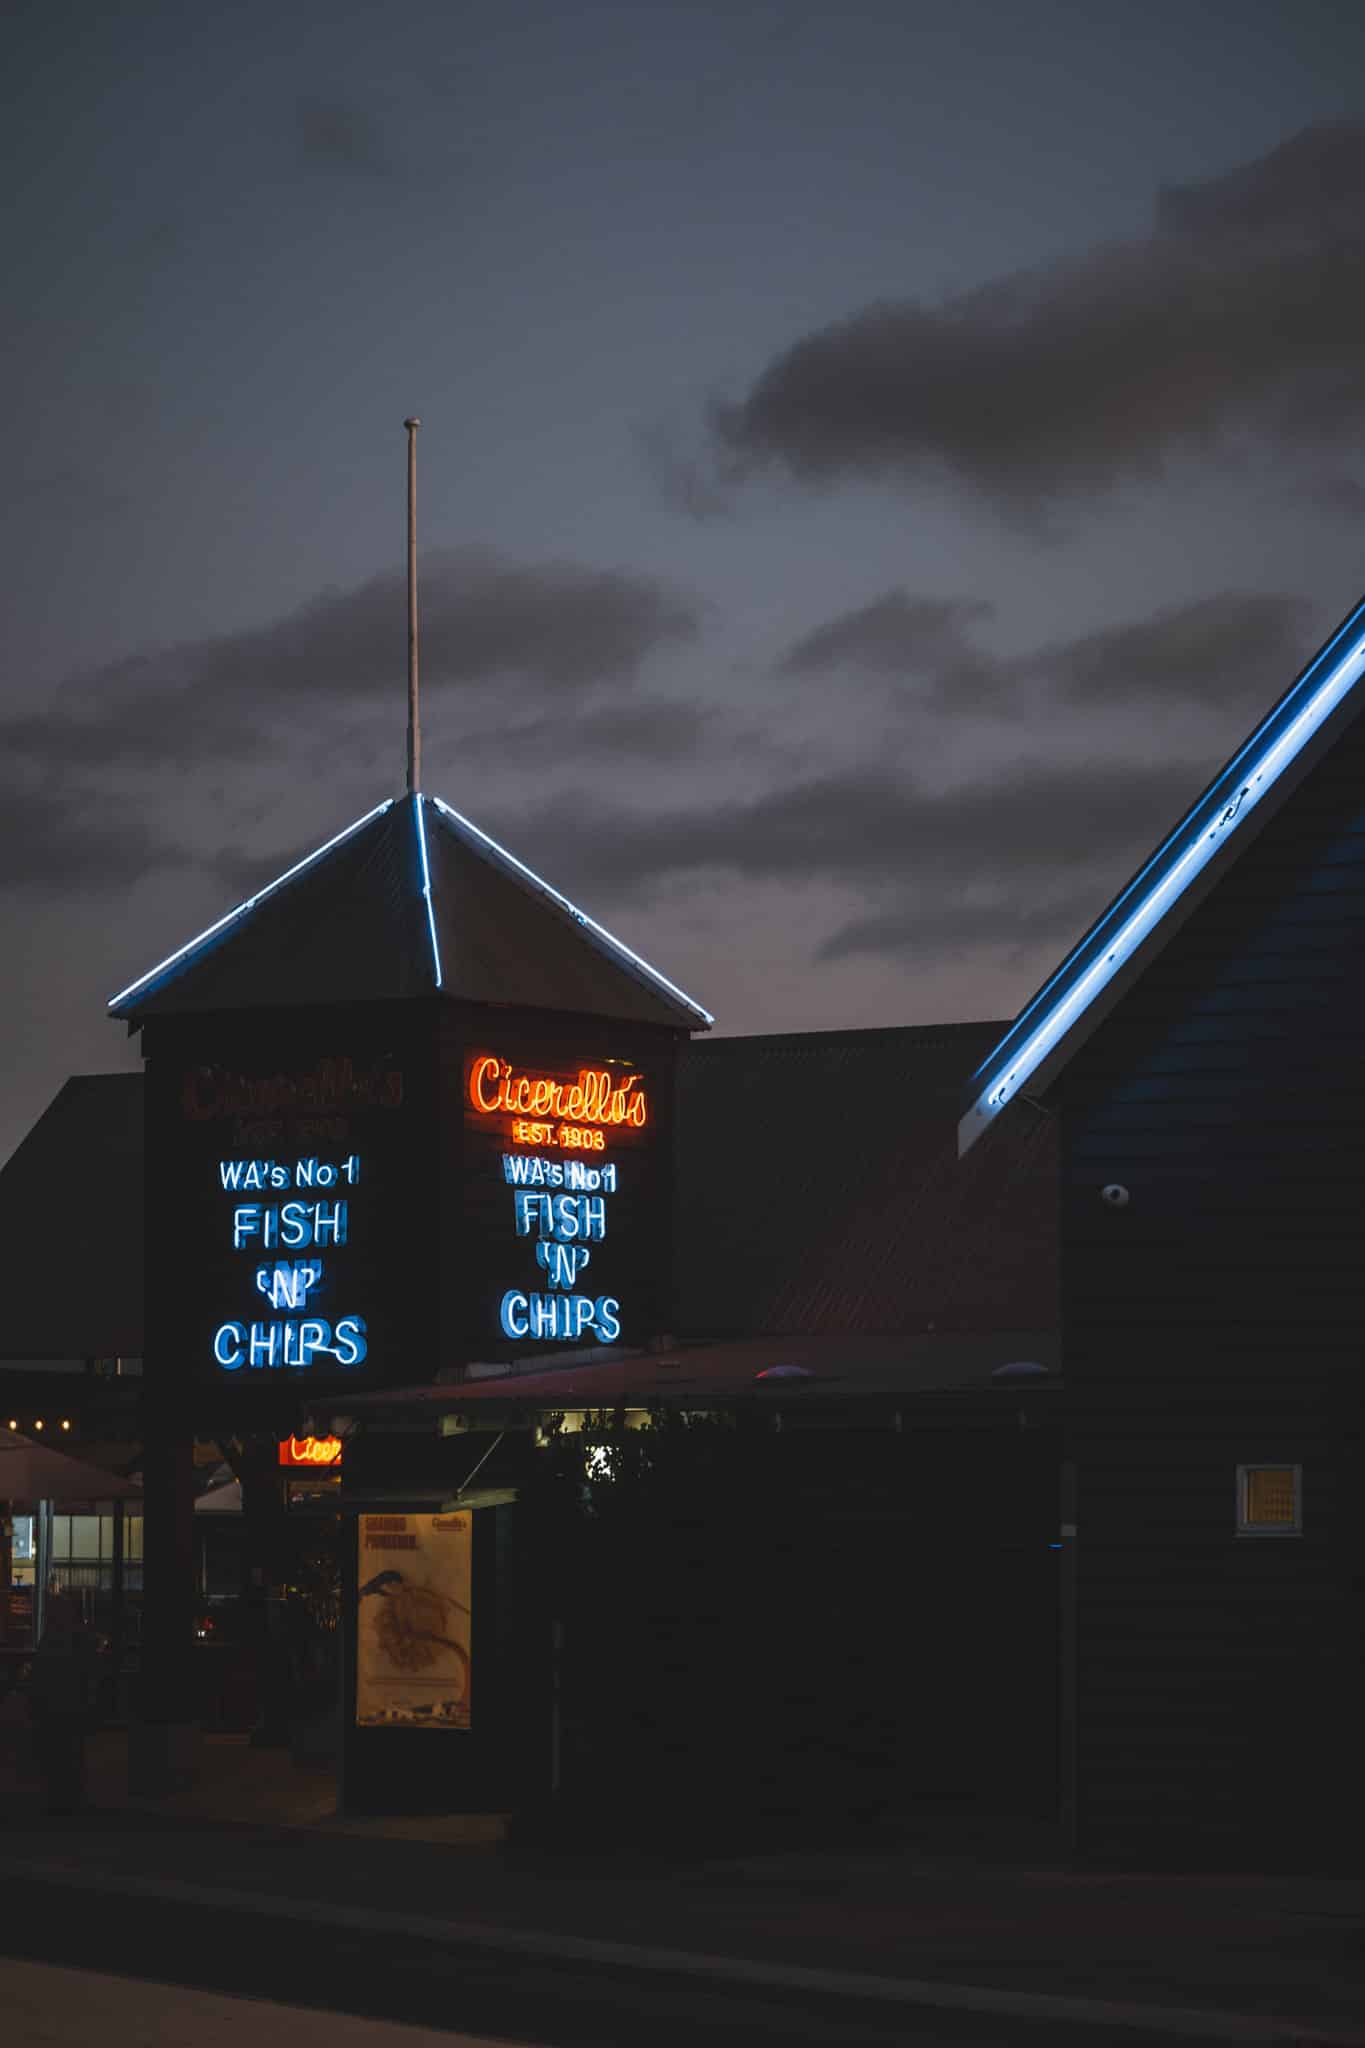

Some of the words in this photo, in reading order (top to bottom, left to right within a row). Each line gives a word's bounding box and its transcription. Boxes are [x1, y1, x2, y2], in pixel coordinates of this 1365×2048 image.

[469, 1057, 647, 1127] Cicerello's
[512, 1119, 558, 1146] EST.
[218, 1156, 288, 1190] WA's
[503, 1154, 564, 1186] WA's
[232, 1200, 348, 1249] FISH
[515, 1190, 606, 1241] FISH
[500, 1290, 621, 1343] CHIPS
[213, 1314, 367, 1371] CHIPS
